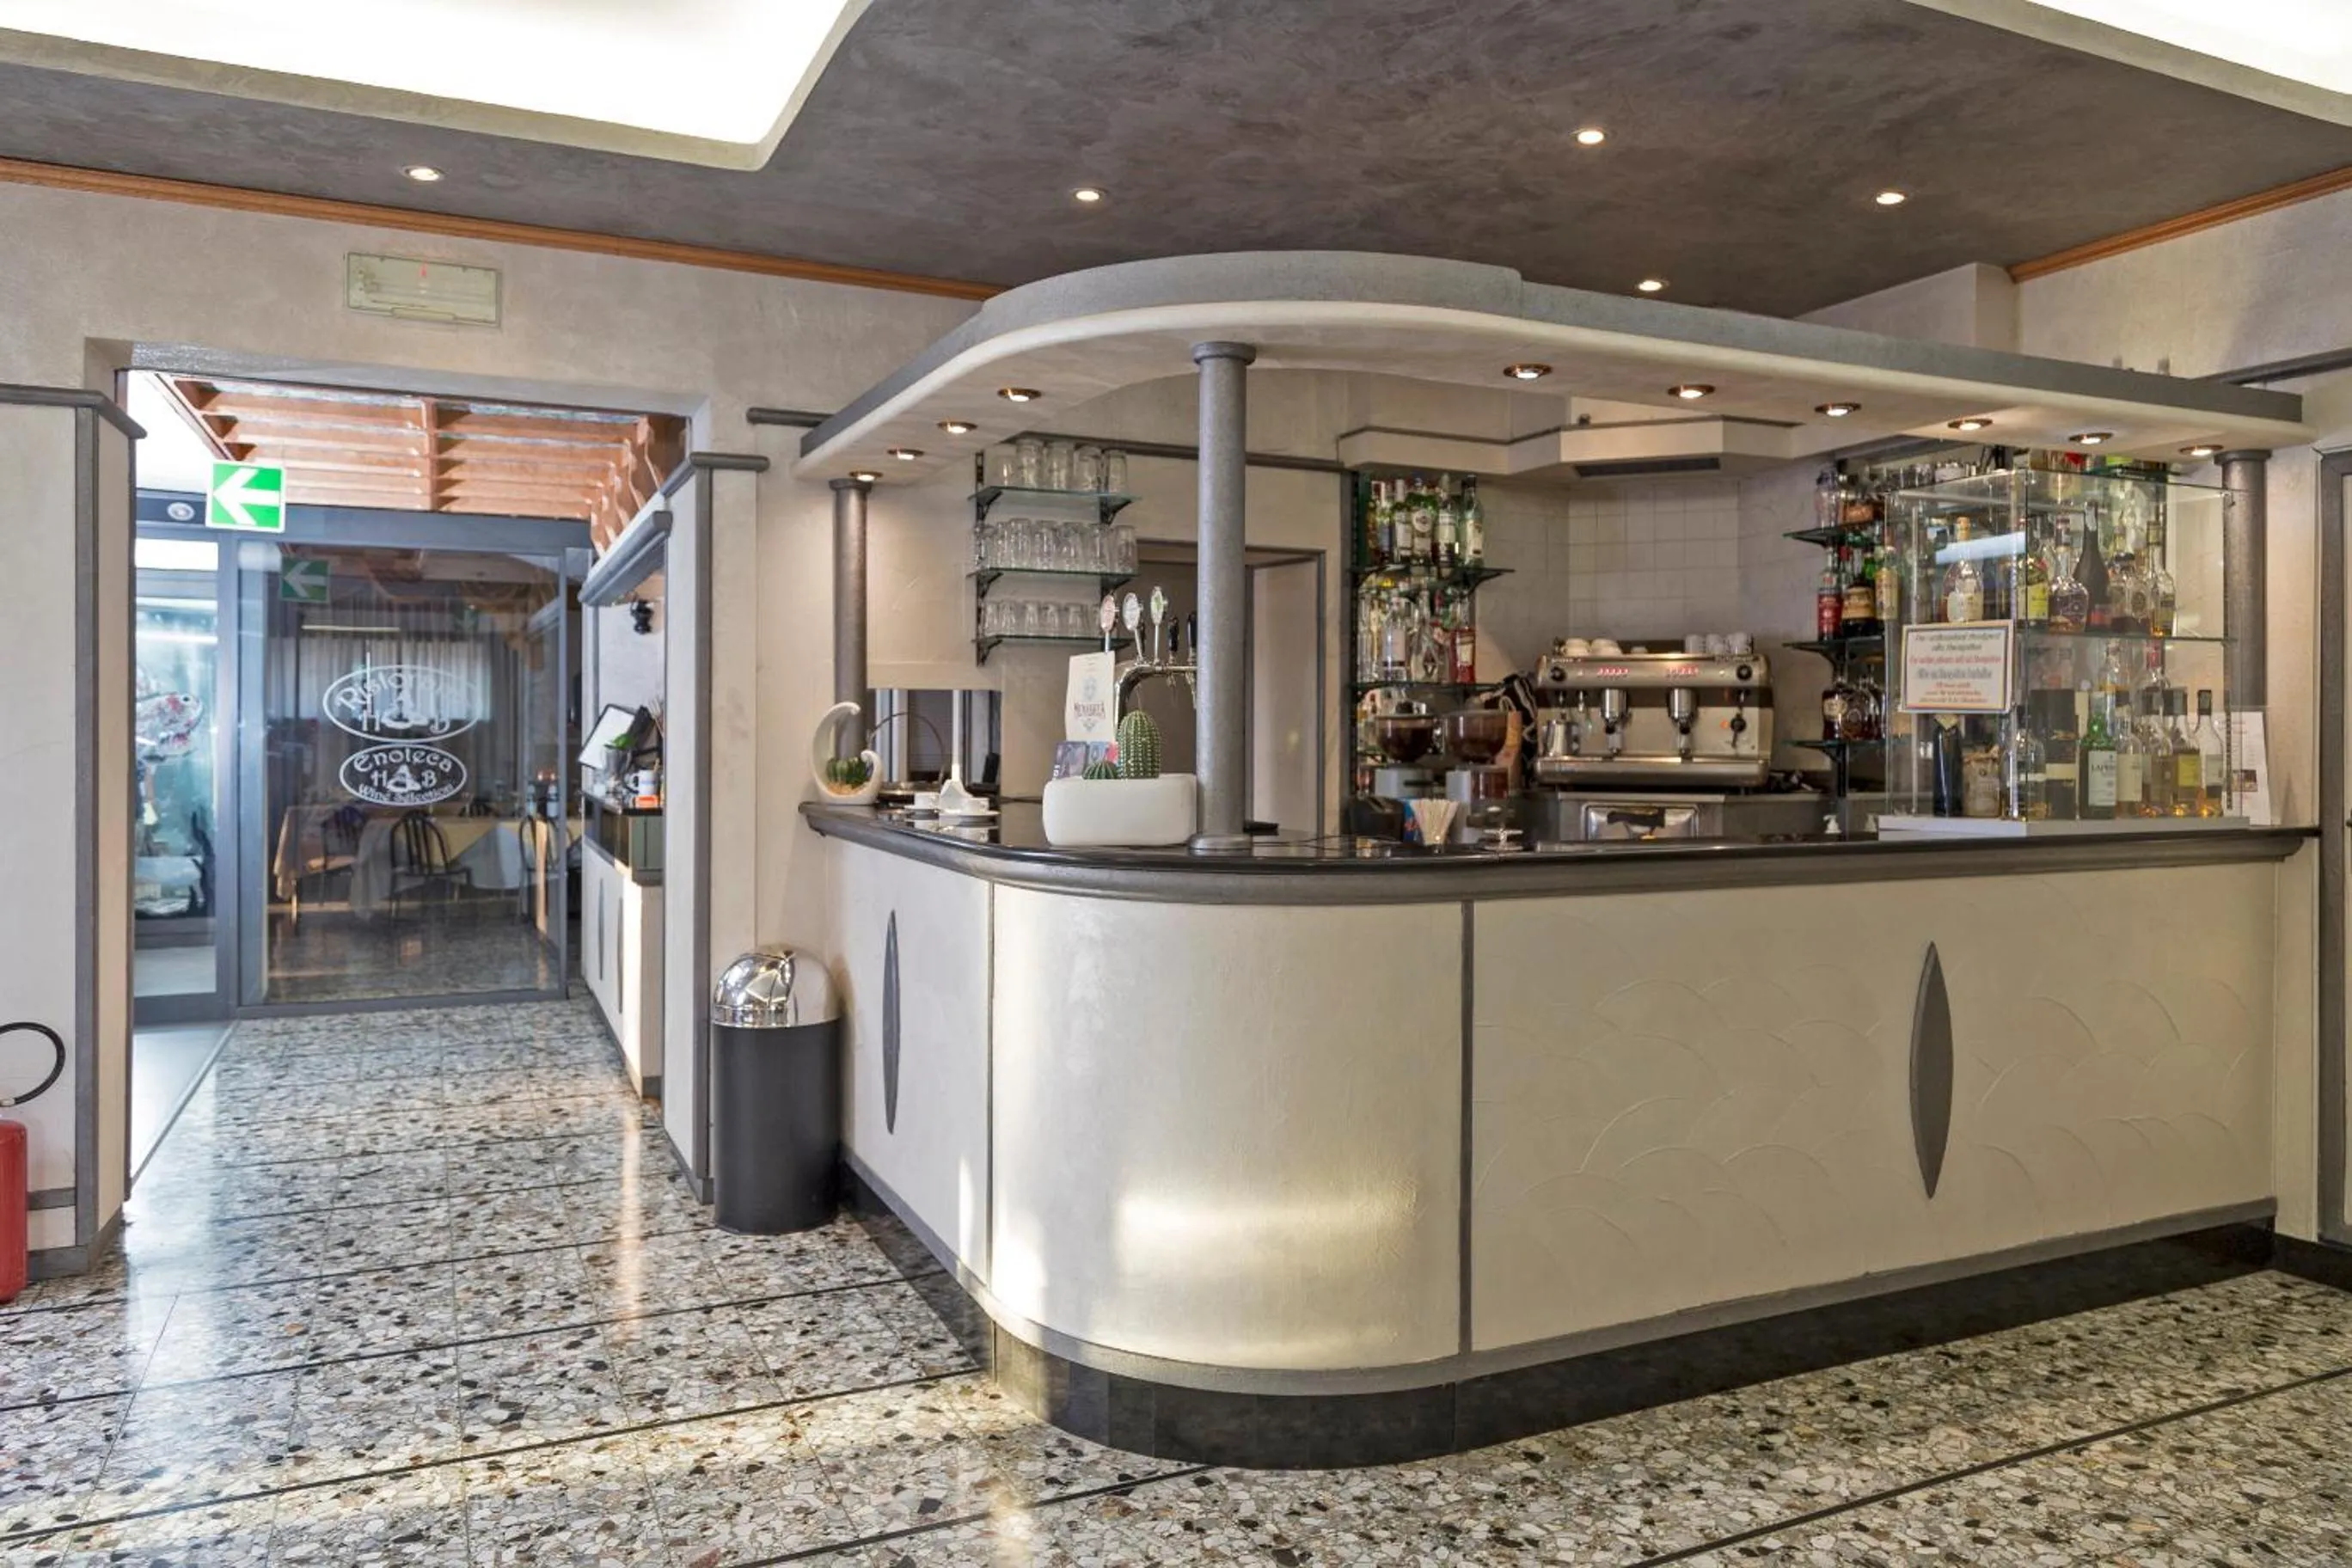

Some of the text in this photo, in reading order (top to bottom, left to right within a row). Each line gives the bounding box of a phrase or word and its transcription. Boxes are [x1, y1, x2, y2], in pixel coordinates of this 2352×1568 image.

[353, 748, 452, 772] Enoteca
[371, 769, 438, 788] H B
